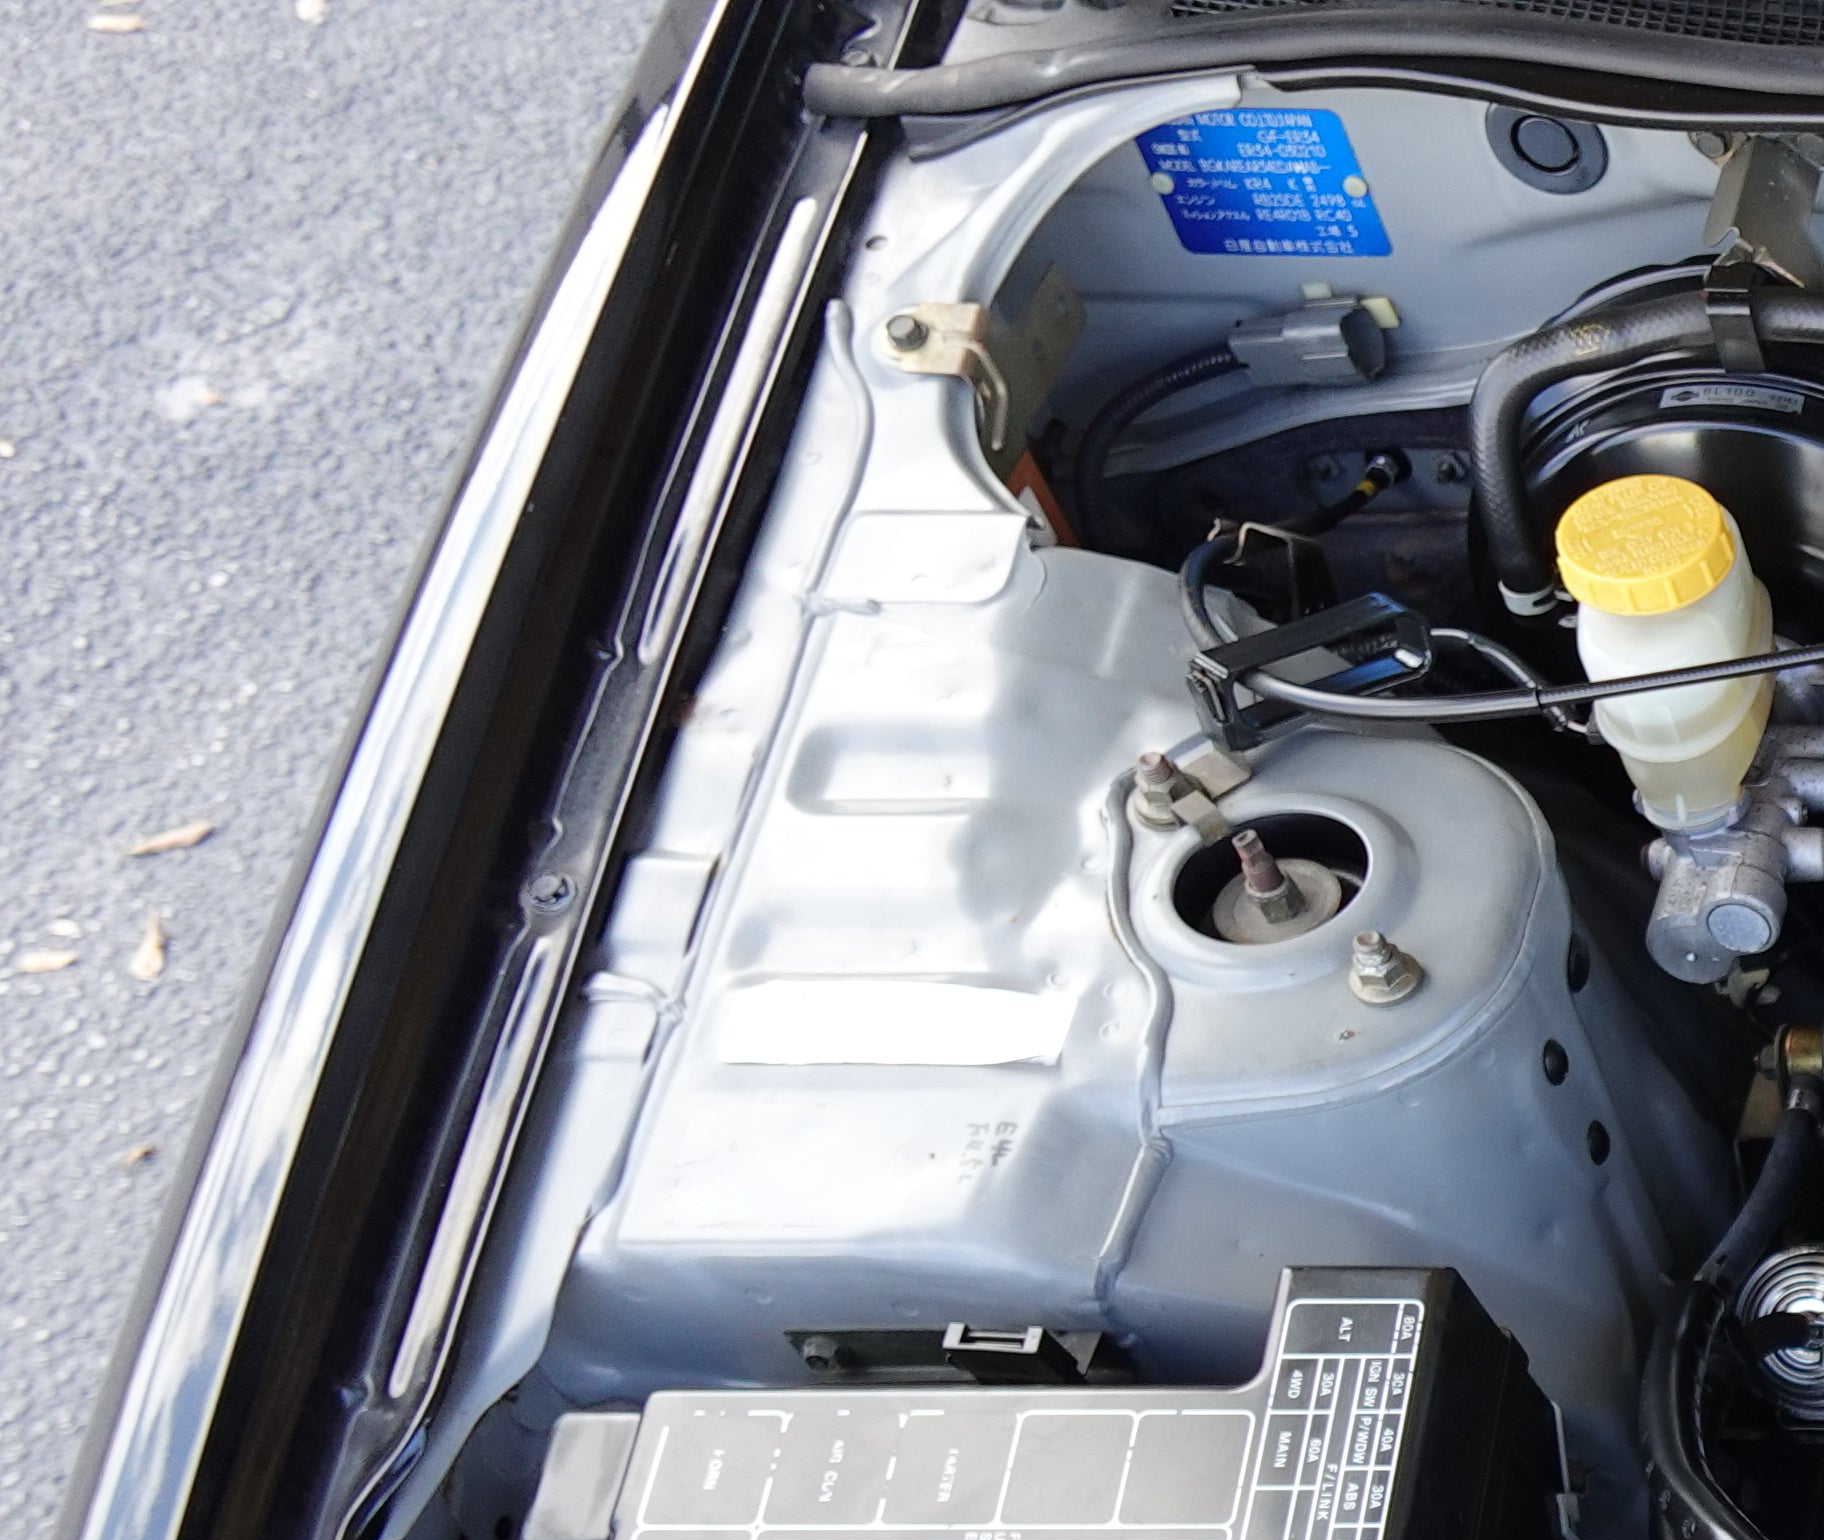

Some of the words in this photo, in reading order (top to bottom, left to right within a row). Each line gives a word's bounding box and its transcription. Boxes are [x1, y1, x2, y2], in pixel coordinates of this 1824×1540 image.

[1338, 1316, 1354, 1342] ALT
[1400, 1315, 1416, 1341] 80A
[1287, 1369, 1304, 1399] 4WD
[1319, 1372, 1335, 1397] 30A
[1368, 1360, 1382, 1383] IGN
[1363, 1387, 1378, 1408] SW
[1274, 1430, 1293, 1468] MAIN
[1307, 1437, 1322, 1463] 60A
[1352, 1416, 1373, 1464] P/WDW
[1379, 1427, 1395, 1452] 40A
[1316, 1463, 1339, 1521] F/LINK
[1343, 1481, 1360, 1511] ABS
[1369, 1484, 1385, 1510] 30A
